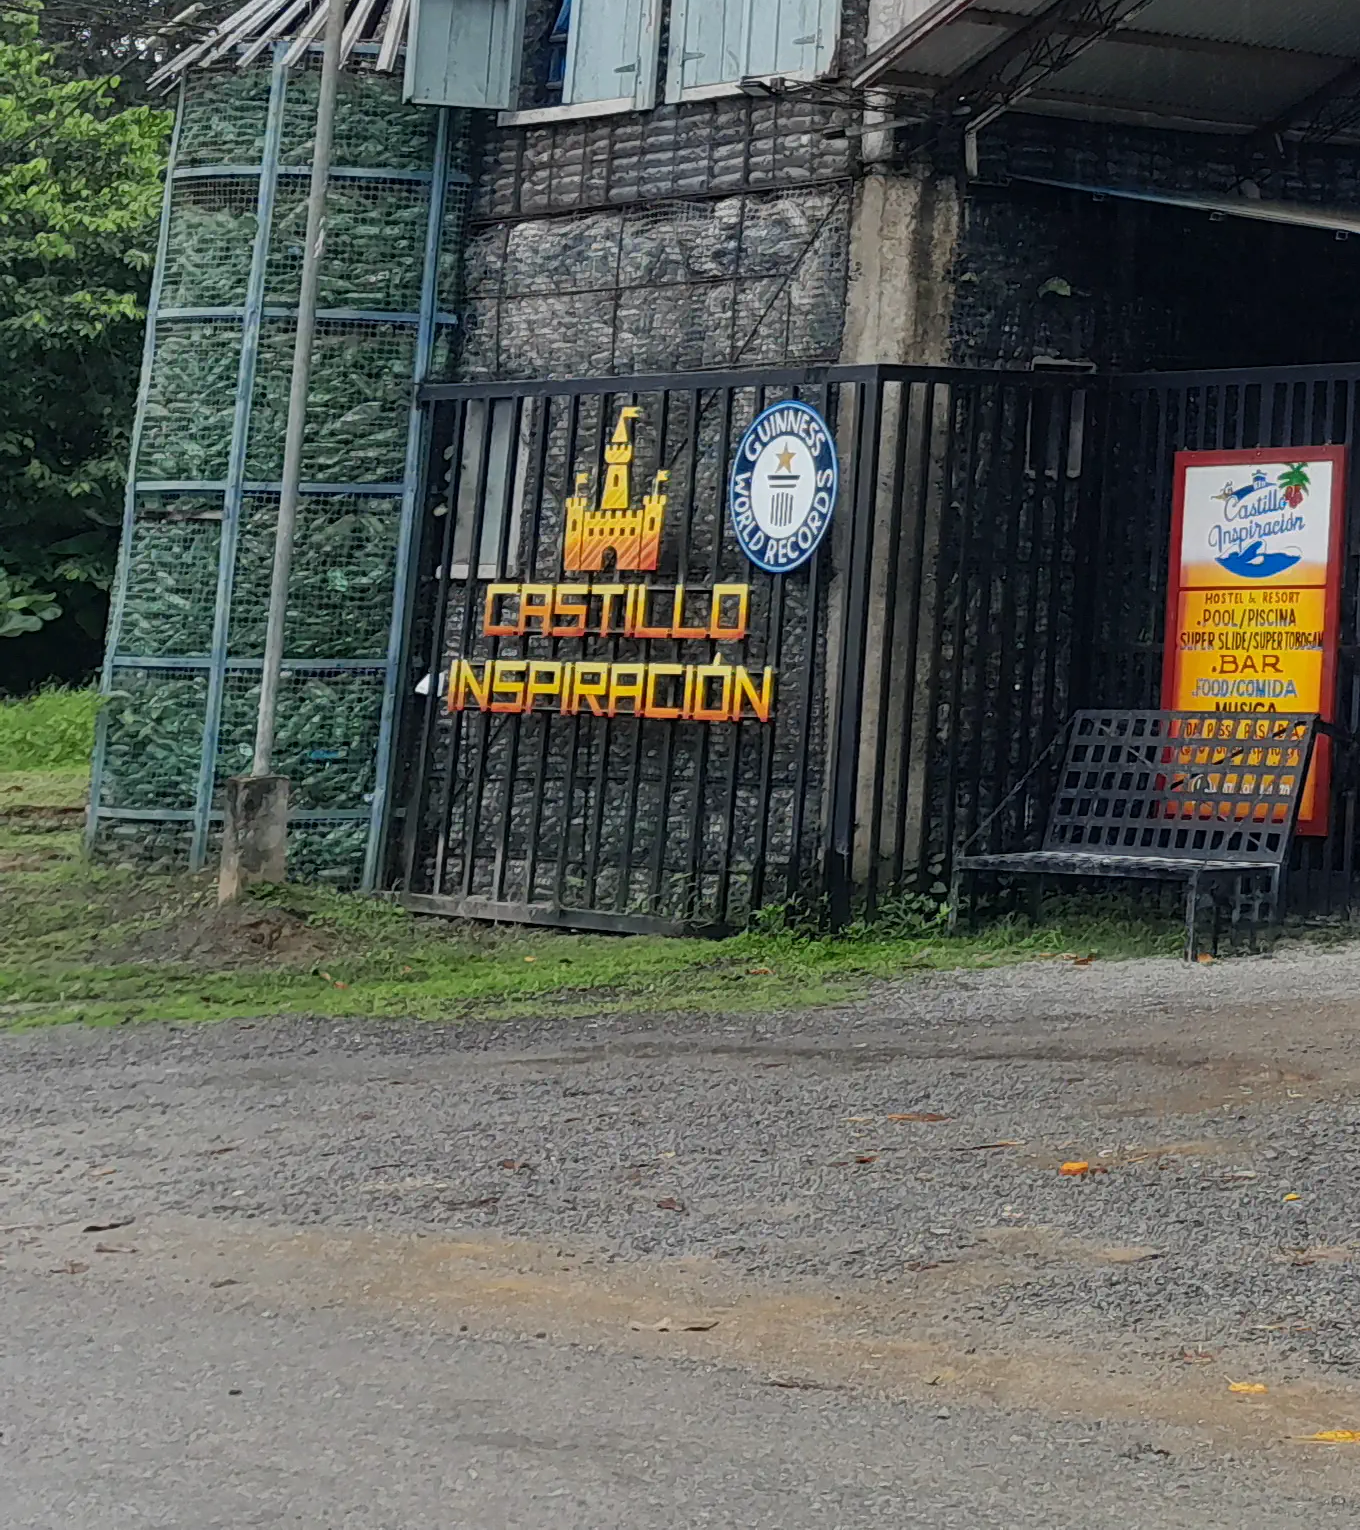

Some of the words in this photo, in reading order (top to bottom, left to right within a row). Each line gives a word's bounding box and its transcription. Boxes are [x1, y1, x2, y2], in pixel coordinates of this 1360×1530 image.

[744, 409, 826, 462] GUINNESS
[734, 471, 765, 551] WORLD
[764, 468, 834, 565] RECORDS
[1224, 488, 1288, 522] Castillo
[483, 583, 750, 640] CASTILLO
[1205, 592, 1243, 605] HOSTEL
[1262, 591, 1300, 604] RESORT
[1180, 631, 1215, 650] SUPER
[447, 652, 772, 723] INSPIRACIÓN
